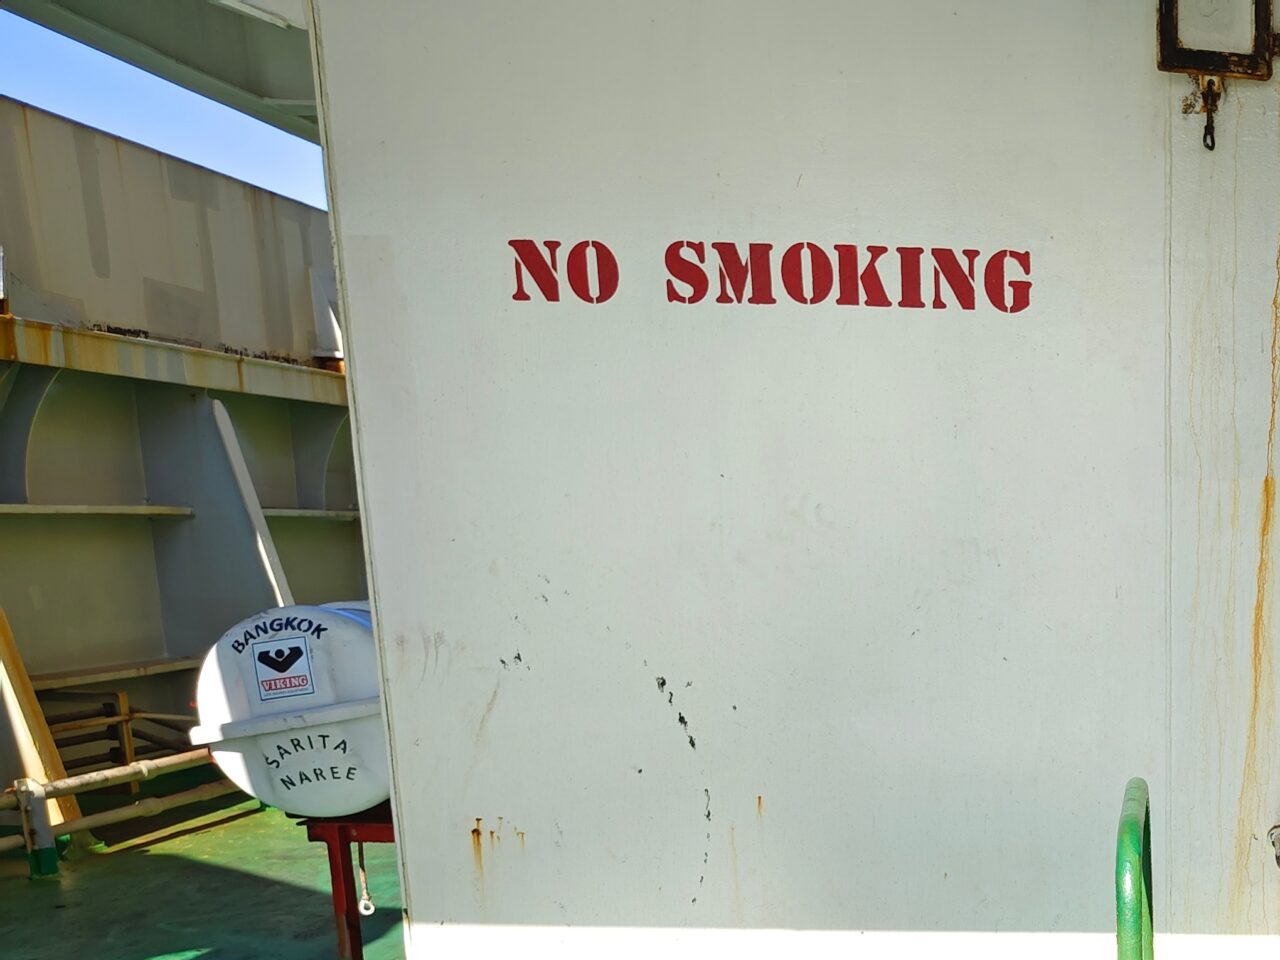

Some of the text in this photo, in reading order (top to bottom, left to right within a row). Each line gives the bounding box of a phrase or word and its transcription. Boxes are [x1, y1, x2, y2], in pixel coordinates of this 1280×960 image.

[508, 239, 1033, 313] NO SMOKING
[232, 616, 328, 654] BANGKOK
[261, 675, 308, 691] VIKING
[265, 734, 348, 769] SARITA
[280, 766, 357, 790] NAREE
